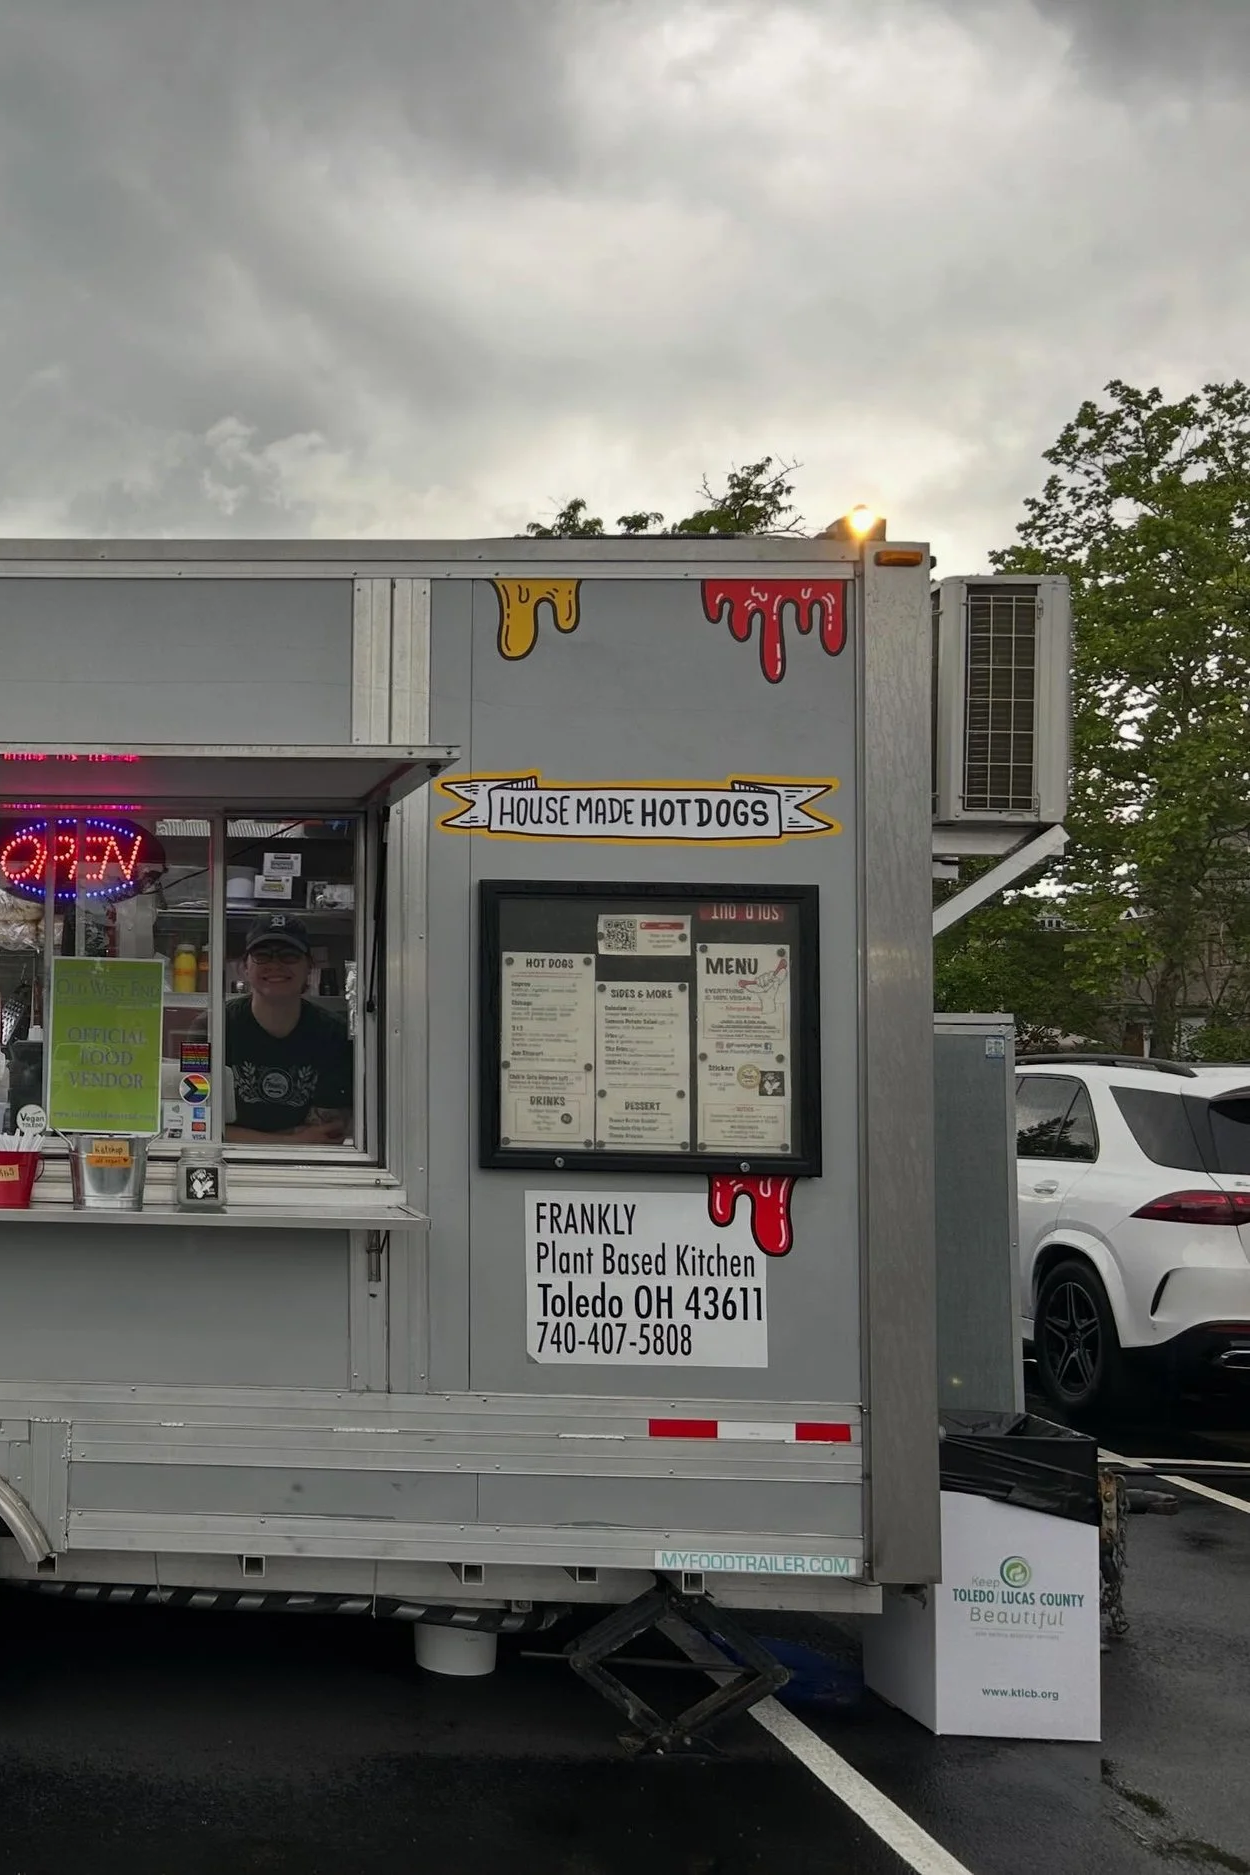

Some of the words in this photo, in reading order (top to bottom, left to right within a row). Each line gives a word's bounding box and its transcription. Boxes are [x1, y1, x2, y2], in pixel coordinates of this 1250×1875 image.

[499, 794, 571, 826] HOUSE
[576, 796, 634, 825] MADE
[640, 797, 691, 829] HOT
[693, 798, 770, 829] DOGS
[0, 834, 143, 880] OPEN
[526, 958, 546, 969] HOT
[548, 958, 574, 969] DOGS
[705, 957, 759, 975] MENU
[90, 979, 127, 998] WEST
[610, 989, 635, 998] SIDES
[637, 989, 644, 998] &
[646, 989, 673, 999] MORE
[68, 1026, 147, 1045] OFFICIAL
[79, 1049, 134, 1067] FOOD
[69, 1071, 143, 1090] VENDOR
[530, 1095, 566, 1106] DRINKS
[624, 1101, 661, 1110] DESSERT
[20, 1112, 44, 1123] Vegan
[536, 1202, 636, 1235] FRANKLY
[536, 1240, 594, 1274] Plant
[602, 1242, 667, 1276] Based
[676, 1243, 755, 1277] Kitchen
[537, 1281, 623, 1318] Toledo
[634, 1284, 673, 1319] OH
[685, 1286, 763, 1321] 43611
[536, 1321, 692, 1356] 740-407-5808
[661, 1552, 850, 1574] MYFOODTRAILER.COM
[971, 1576, 1000, 1589] Keep
[1039, 1593, 1085, 1608] COUNTY
[969, 1606, 1065, 1630] Beautiful
